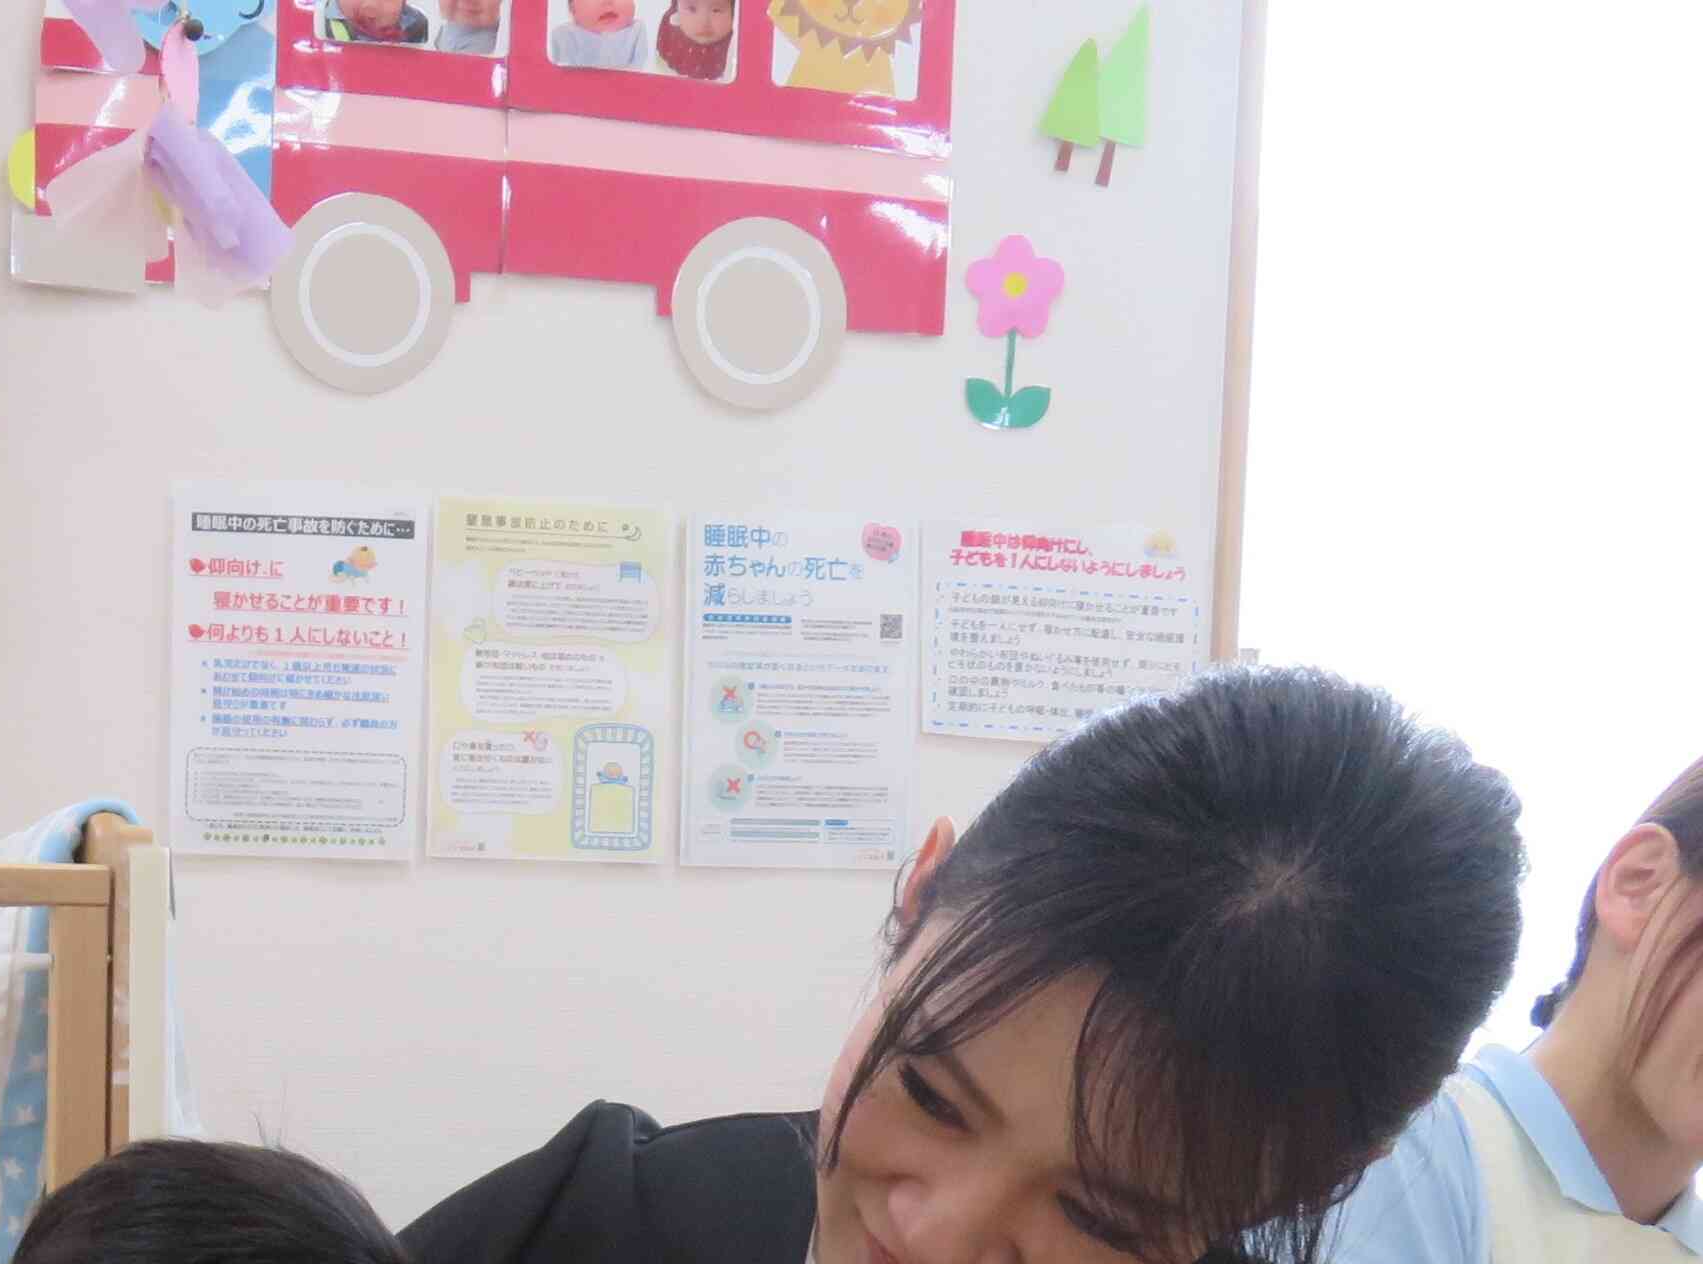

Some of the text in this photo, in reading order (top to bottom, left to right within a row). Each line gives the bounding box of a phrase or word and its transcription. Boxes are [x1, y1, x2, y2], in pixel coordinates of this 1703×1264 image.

[704, 523, 788, 549] 睡眠中の
[704, 553, 865, 581] 赤ちゃんの死亡を
